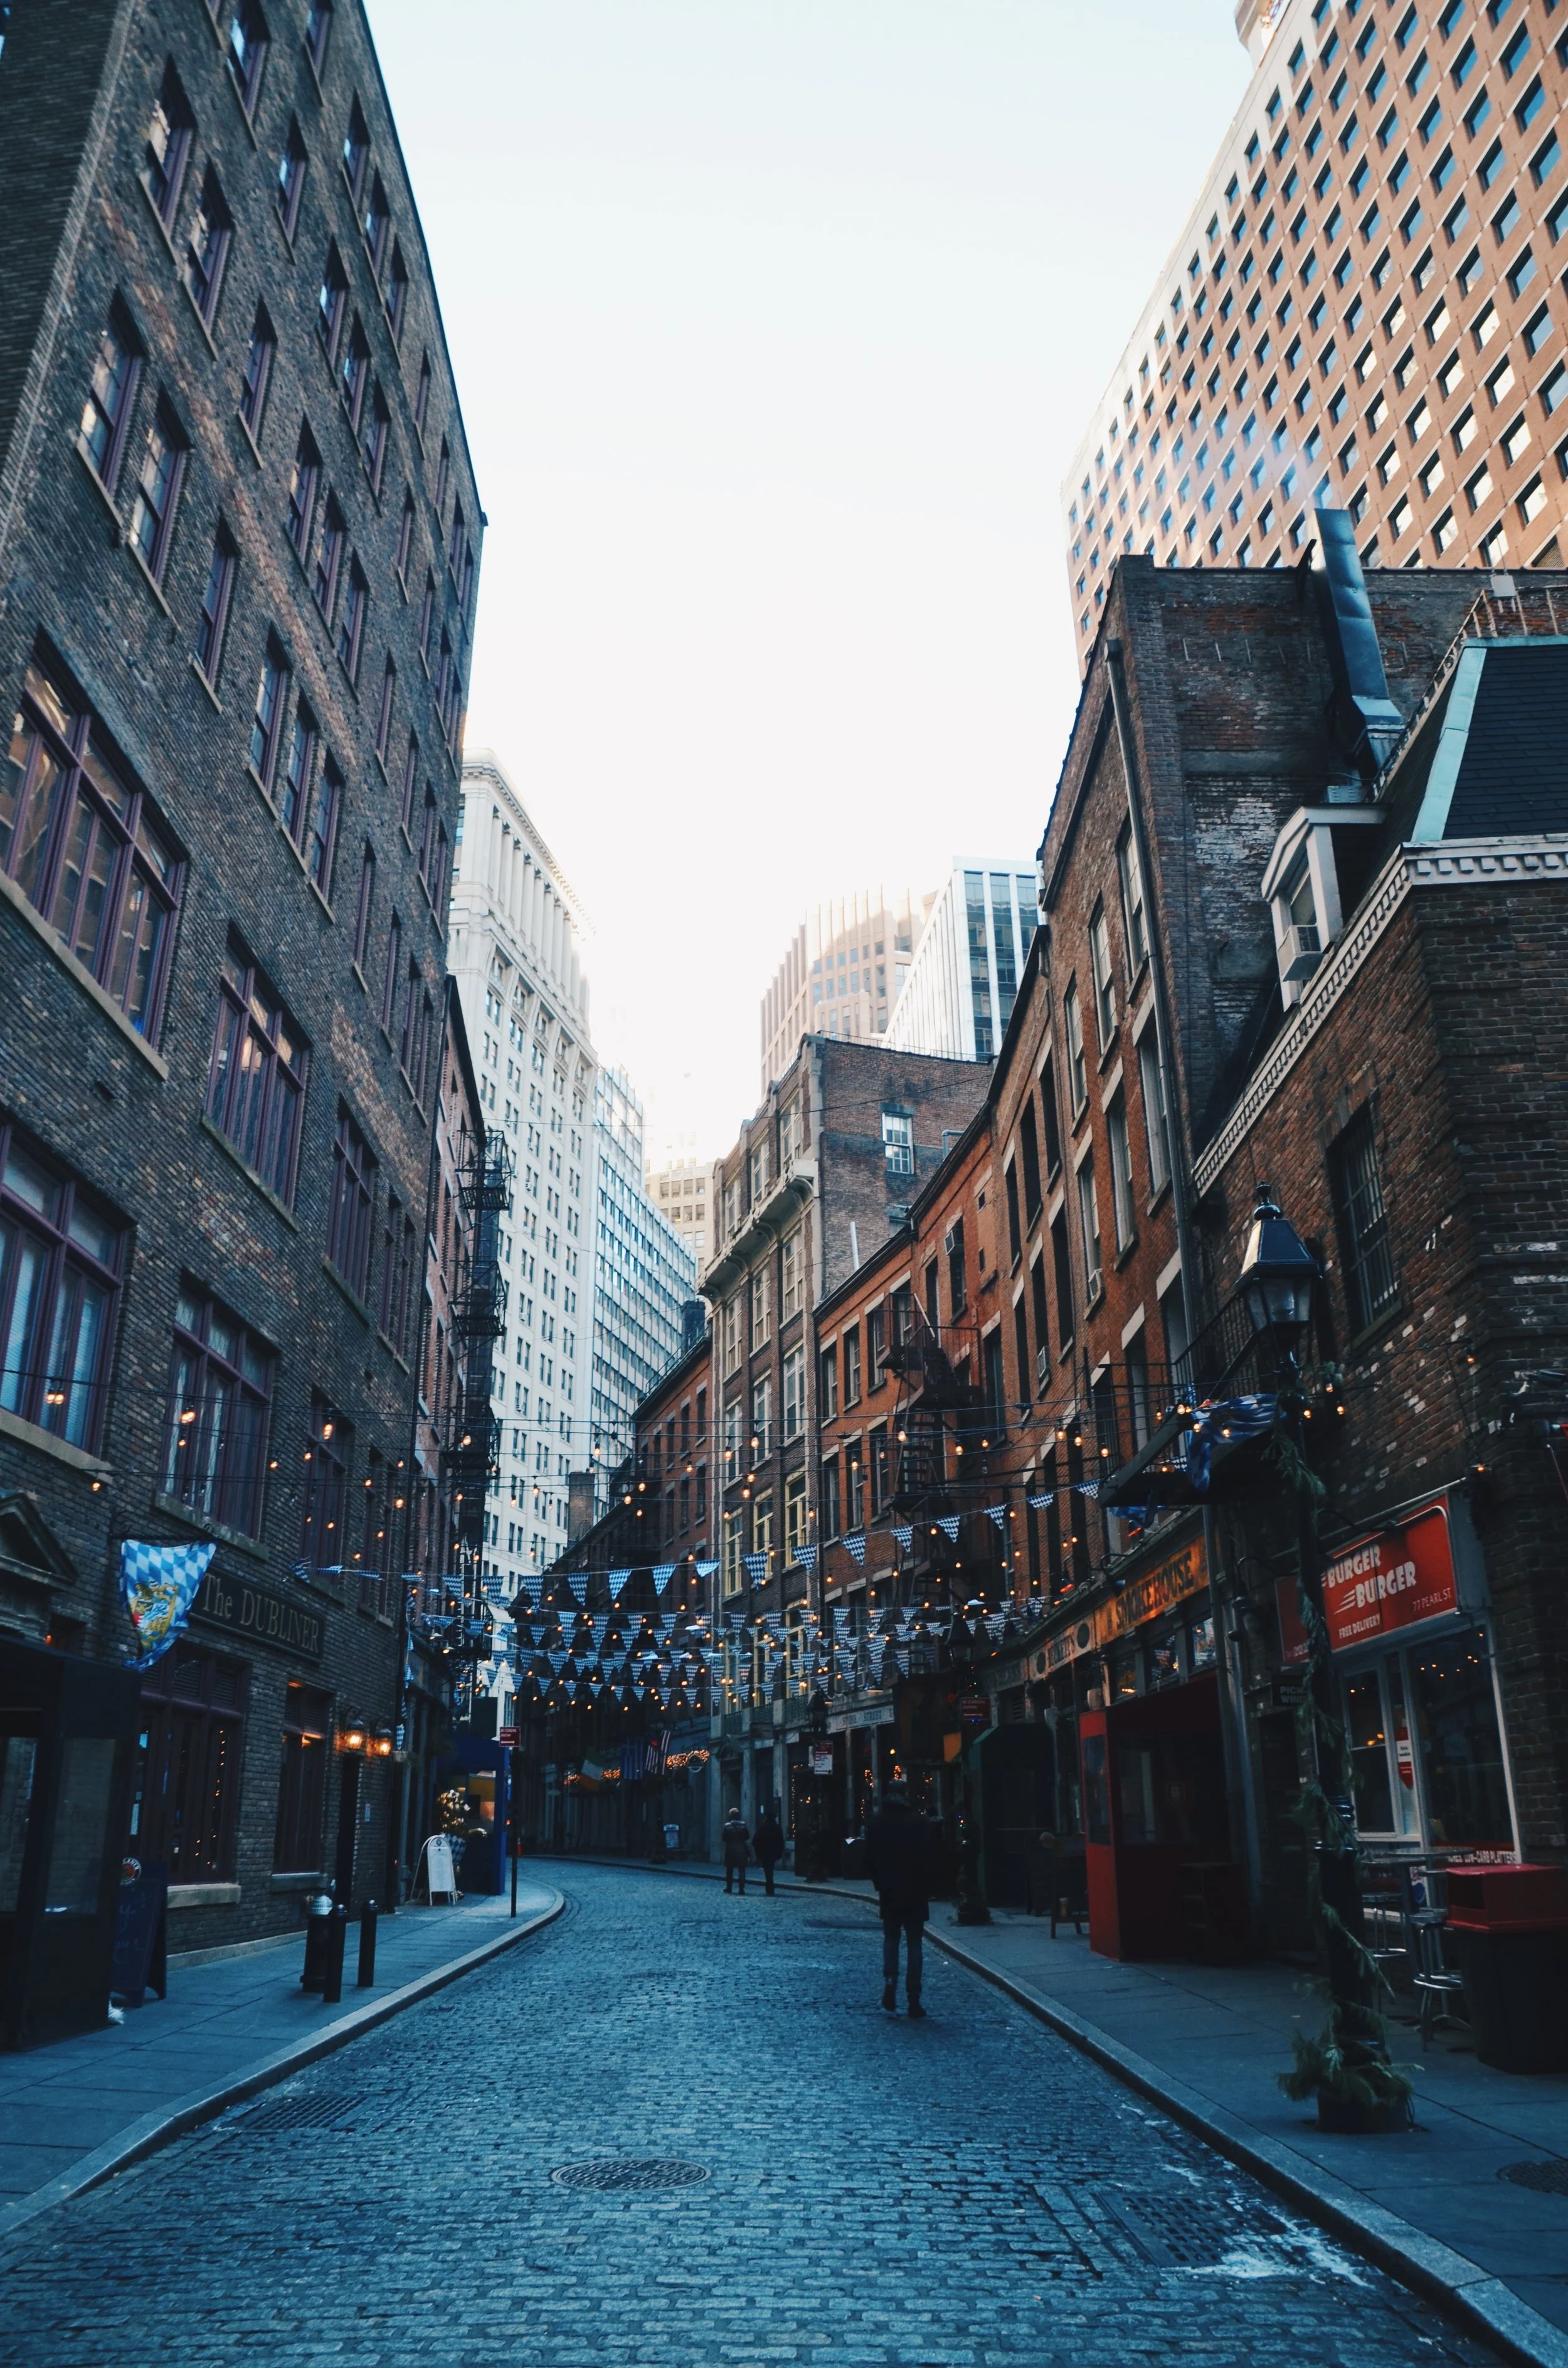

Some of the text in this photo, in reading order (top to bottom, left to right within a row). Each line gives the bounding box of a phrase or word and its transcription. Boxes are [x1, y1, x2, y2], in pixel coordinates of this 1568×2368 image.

[1327, 1543, 1382, 1588] BURGER
[1355, 1561, 1417, 1608] BURGER
[203, 1573, 319, 1654] The DUBLINER
[1116, 1552, 1194, 1629] SMOKEHOUSE
[1412, 1587, 1451, 1611] 77 PEARL ST
[1338, 1613, 1380, 1639] FREE DELIVERY
